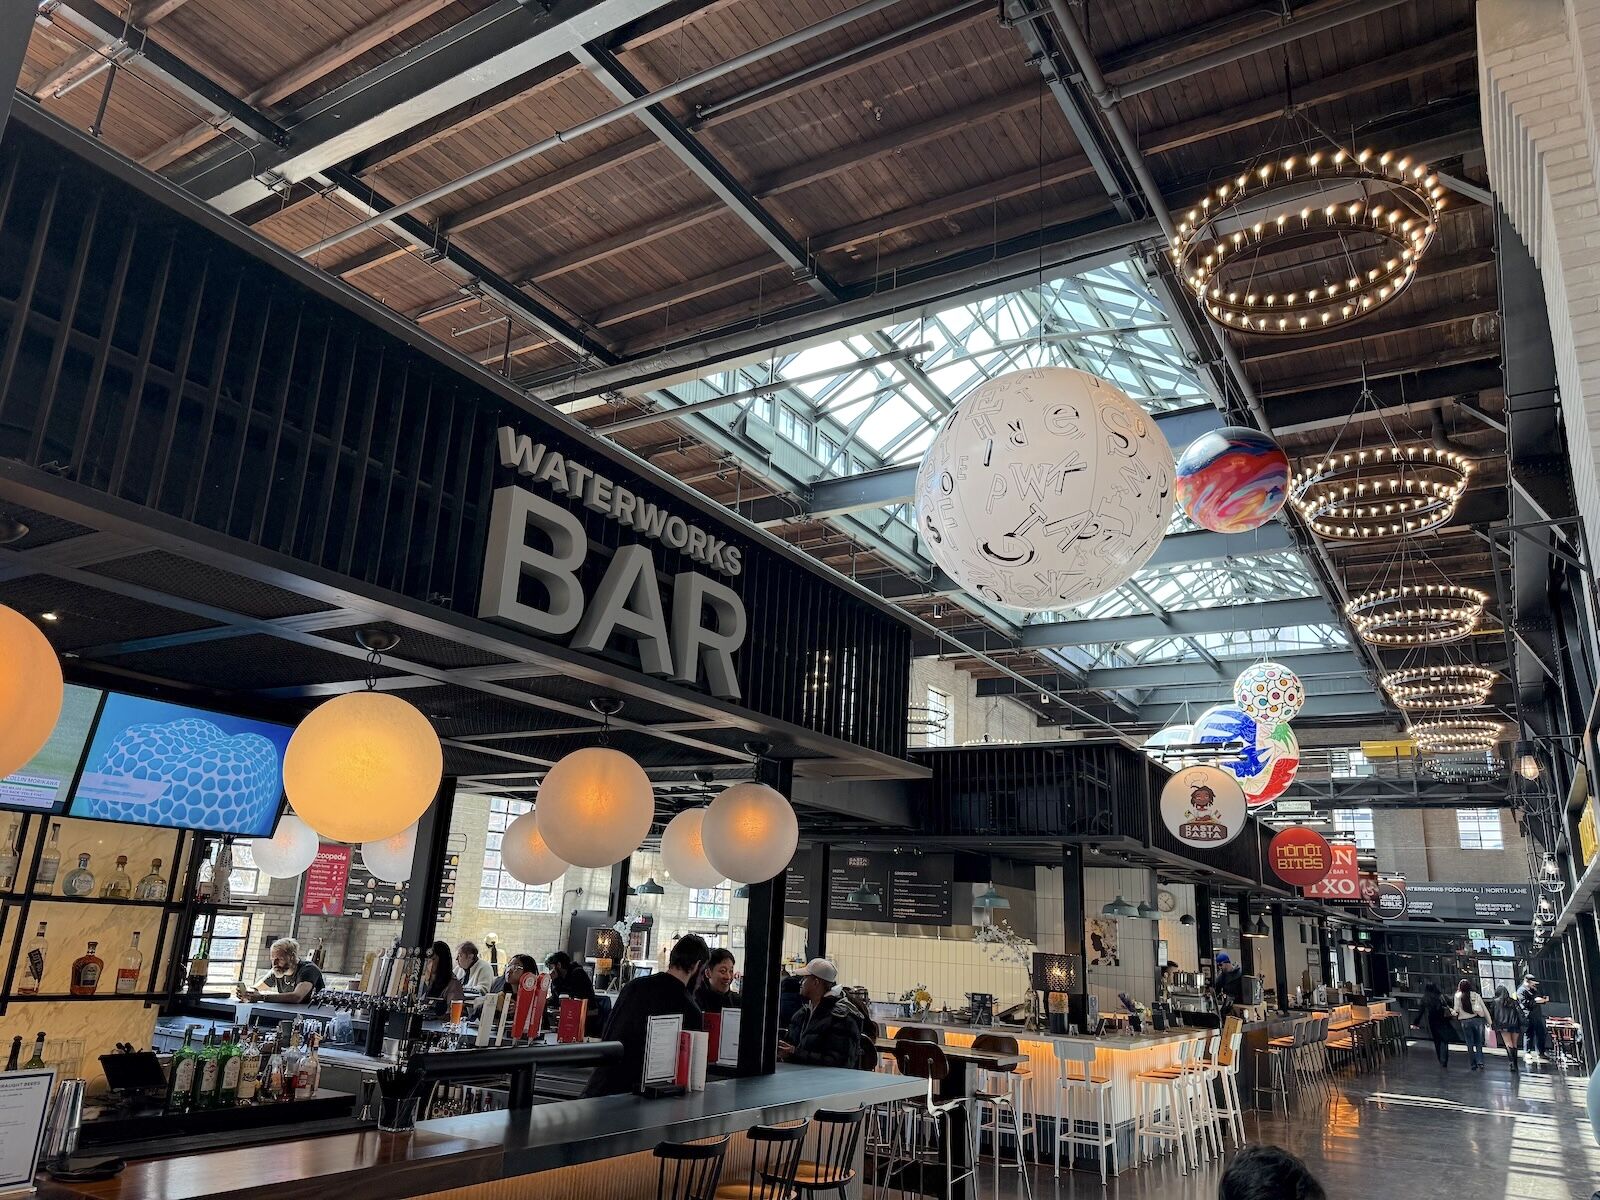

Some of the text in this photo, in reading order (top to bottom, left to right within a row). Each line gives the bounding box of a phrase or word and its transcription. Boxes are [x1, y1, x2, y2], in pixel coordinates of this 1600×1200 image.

[498, 426, 742, 576] WATERWORKS
[478, 485, 747, 699] BAR
[6, 775, 58, 786] COLLIN MORIKAWA
[1444, 886, 1462, 894] FOOD
